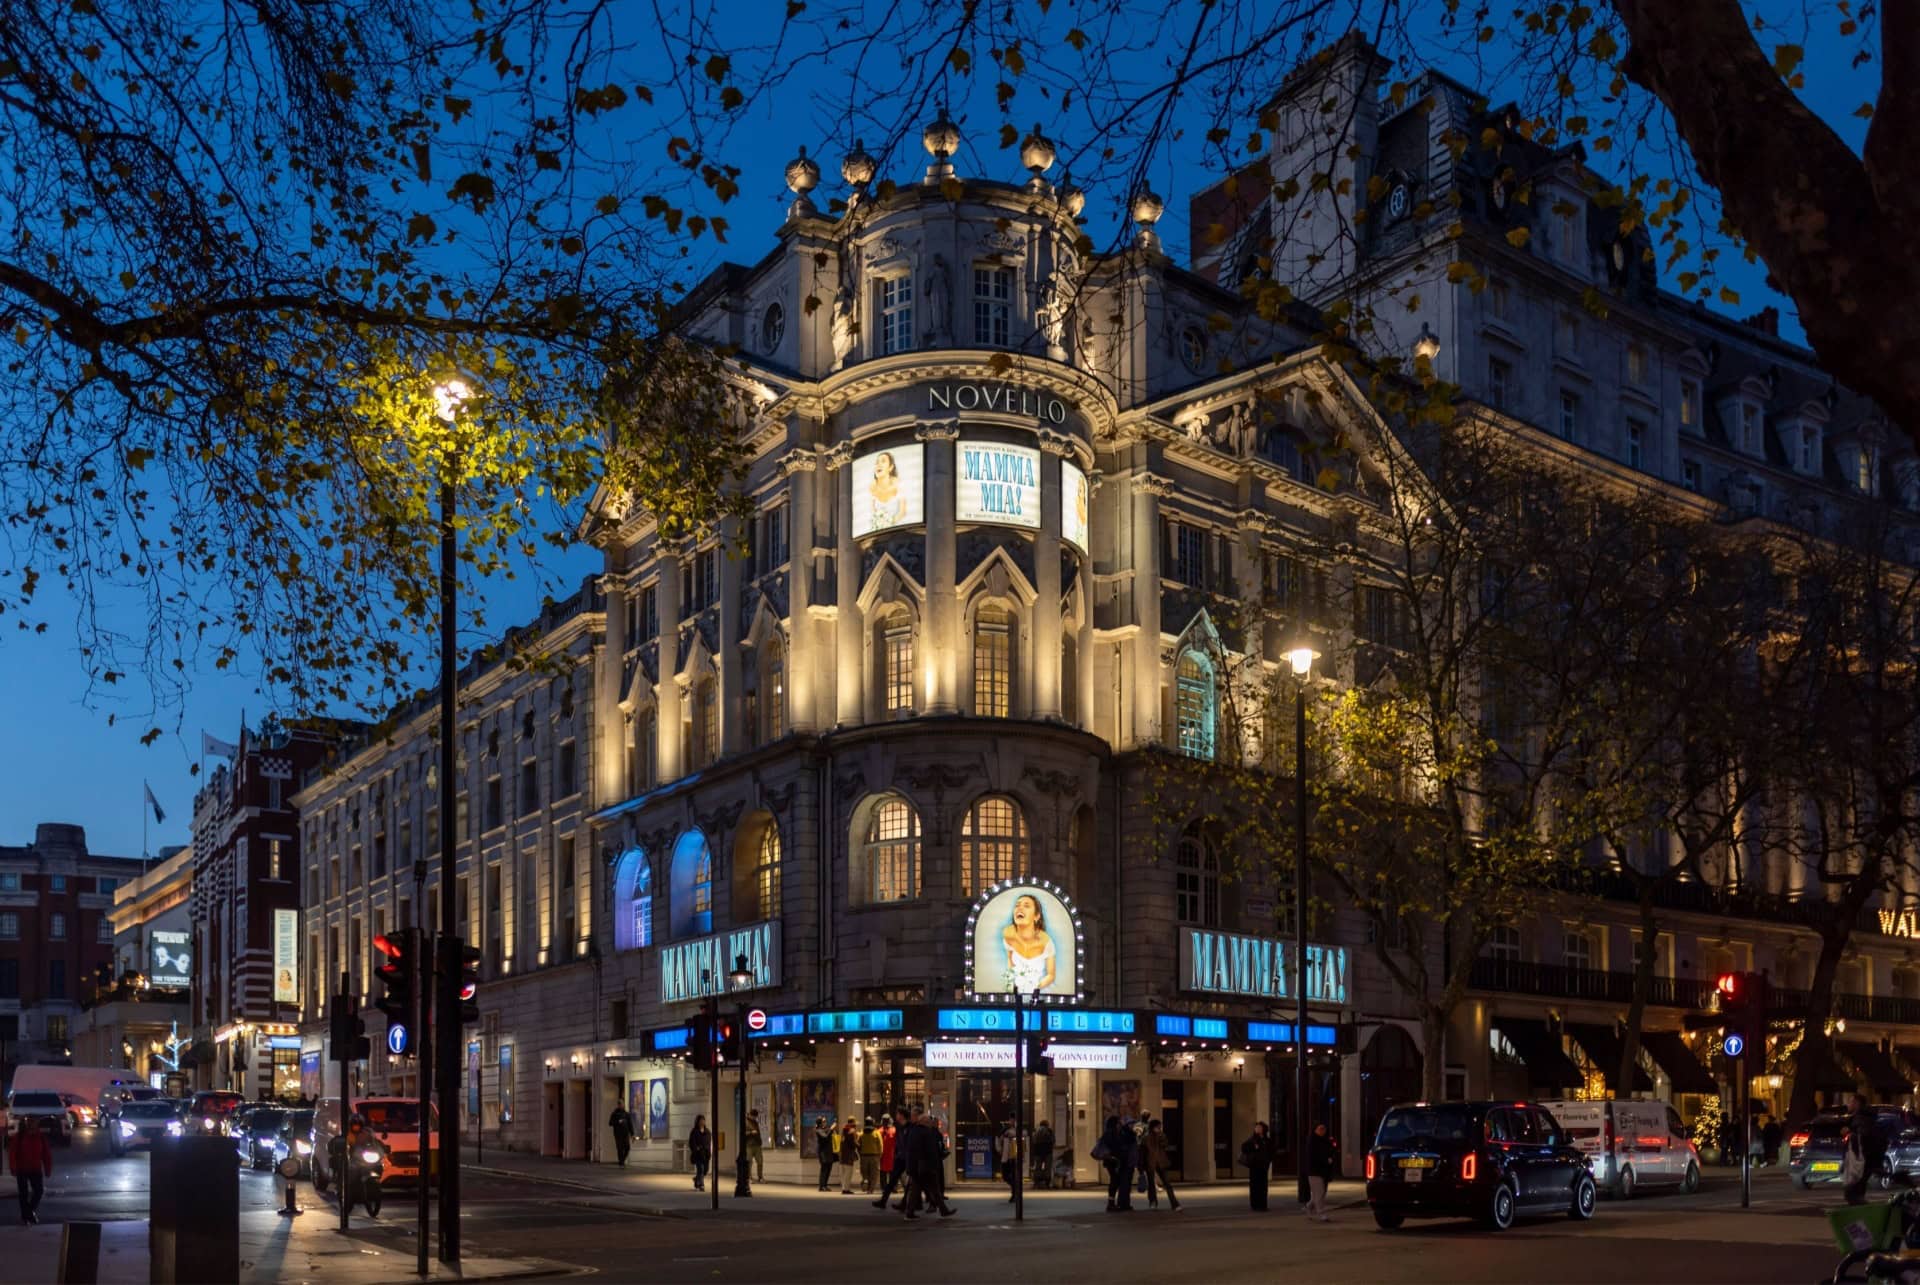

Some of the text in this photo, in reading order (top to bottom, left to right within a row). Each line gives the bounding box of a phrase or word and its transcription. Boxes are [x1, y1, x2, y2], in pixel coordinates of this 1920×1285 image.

[928, 385, 1066, 424] NOVELLO
[964, 450, 1035, 488] MAMMA
[980, 481, 1023, 516] MIA!
[661, 937, 725, 1003] MAMMA
[1190, 931, 1288, 998] MAMMA
[931, 1051, 950, 1061] YOU
[953, 1052, 994, 1061] ALREADY
[1058, 1053, 1088, 1062] GONNA
[1089, 1053, 1110, 1062] LOVE
[1110, 1054, 1122, 1062] IT!
